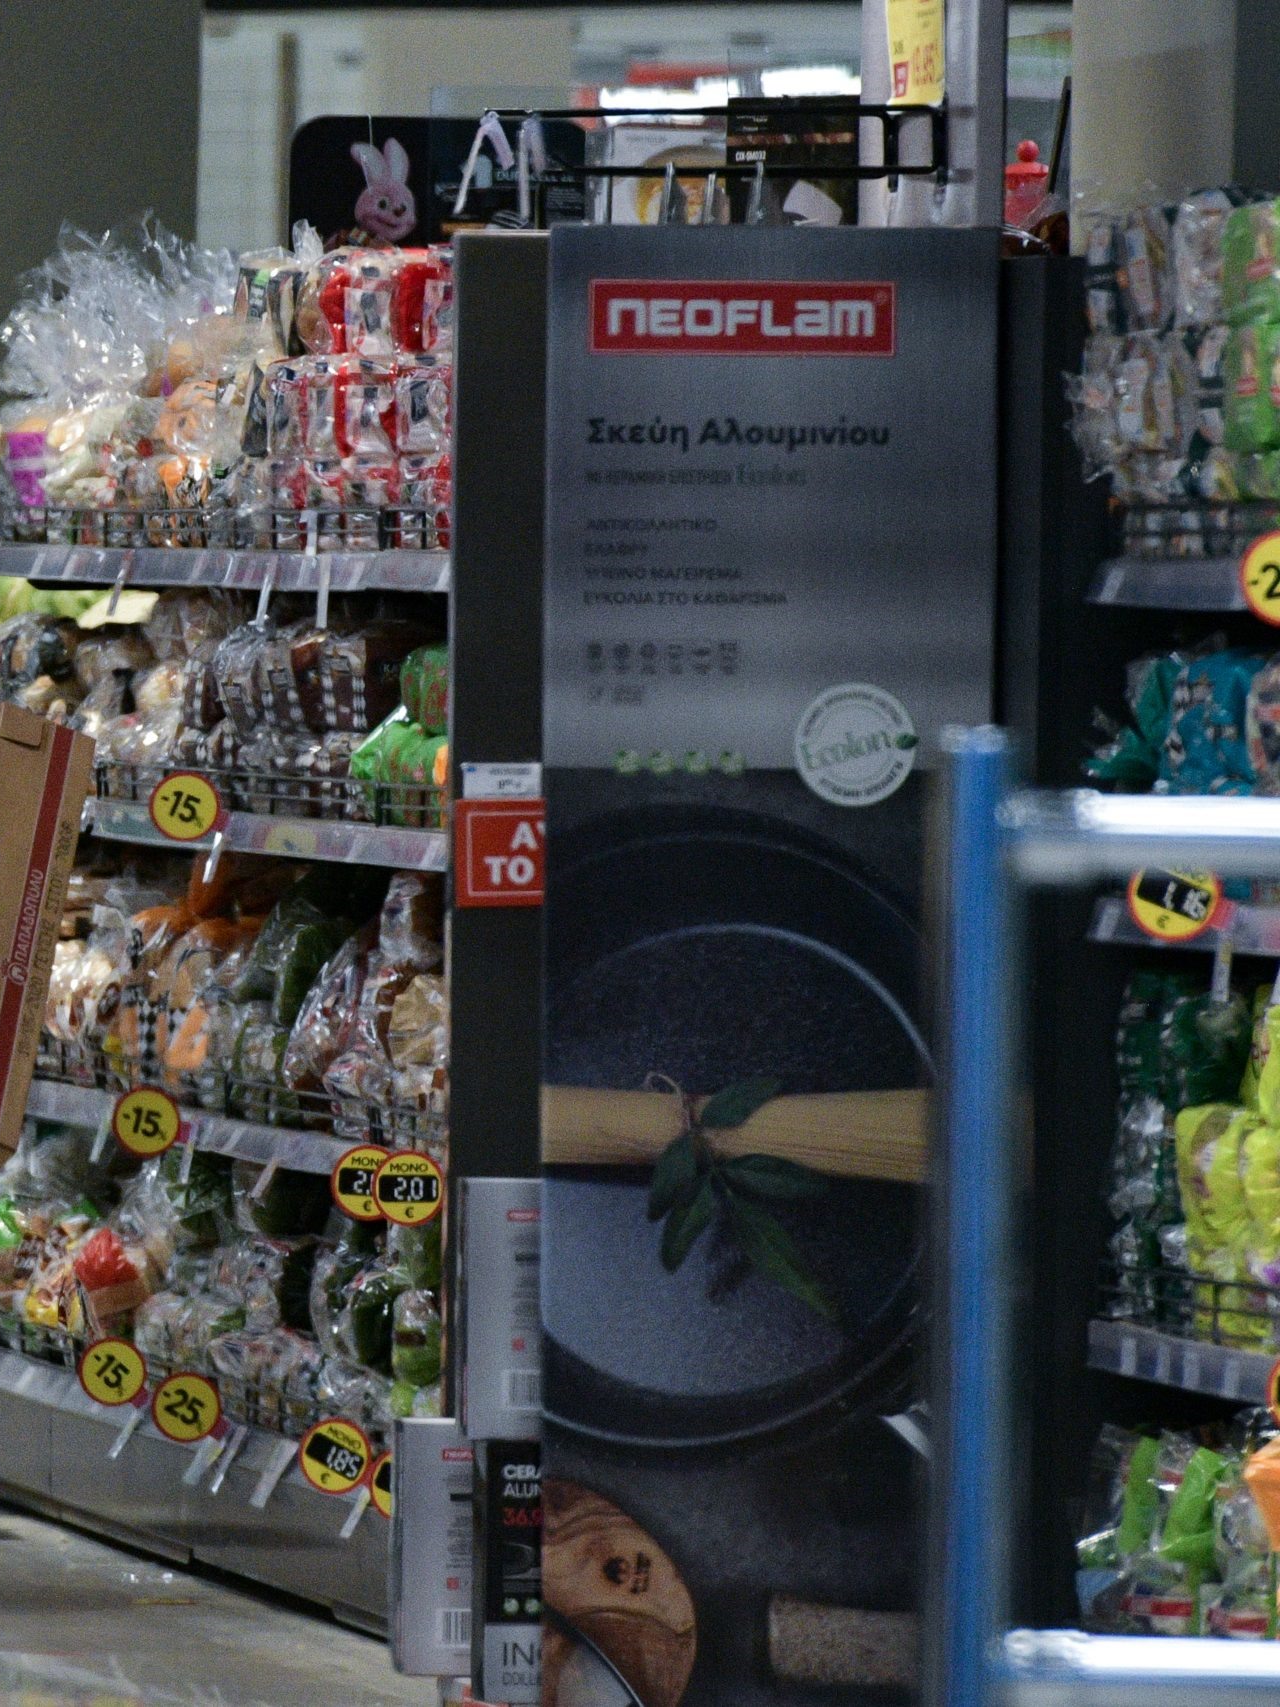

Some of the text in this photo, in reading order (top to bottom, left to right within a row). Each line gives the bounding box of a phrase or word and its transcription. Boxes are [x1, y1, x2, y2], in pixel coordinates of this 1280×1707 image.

[587, 416, 890, 453] Σκεύη Αλουμινίου
[351, 1156, 380, 1166] MON
[389, 1163, 429, 1173] MONO
[363, 1200, 372, 1212] €
[405, 1206, 415, 1218] €
[327, 1425, 362, 1450] MONO
[502, 1641, 541, 1667] IN
